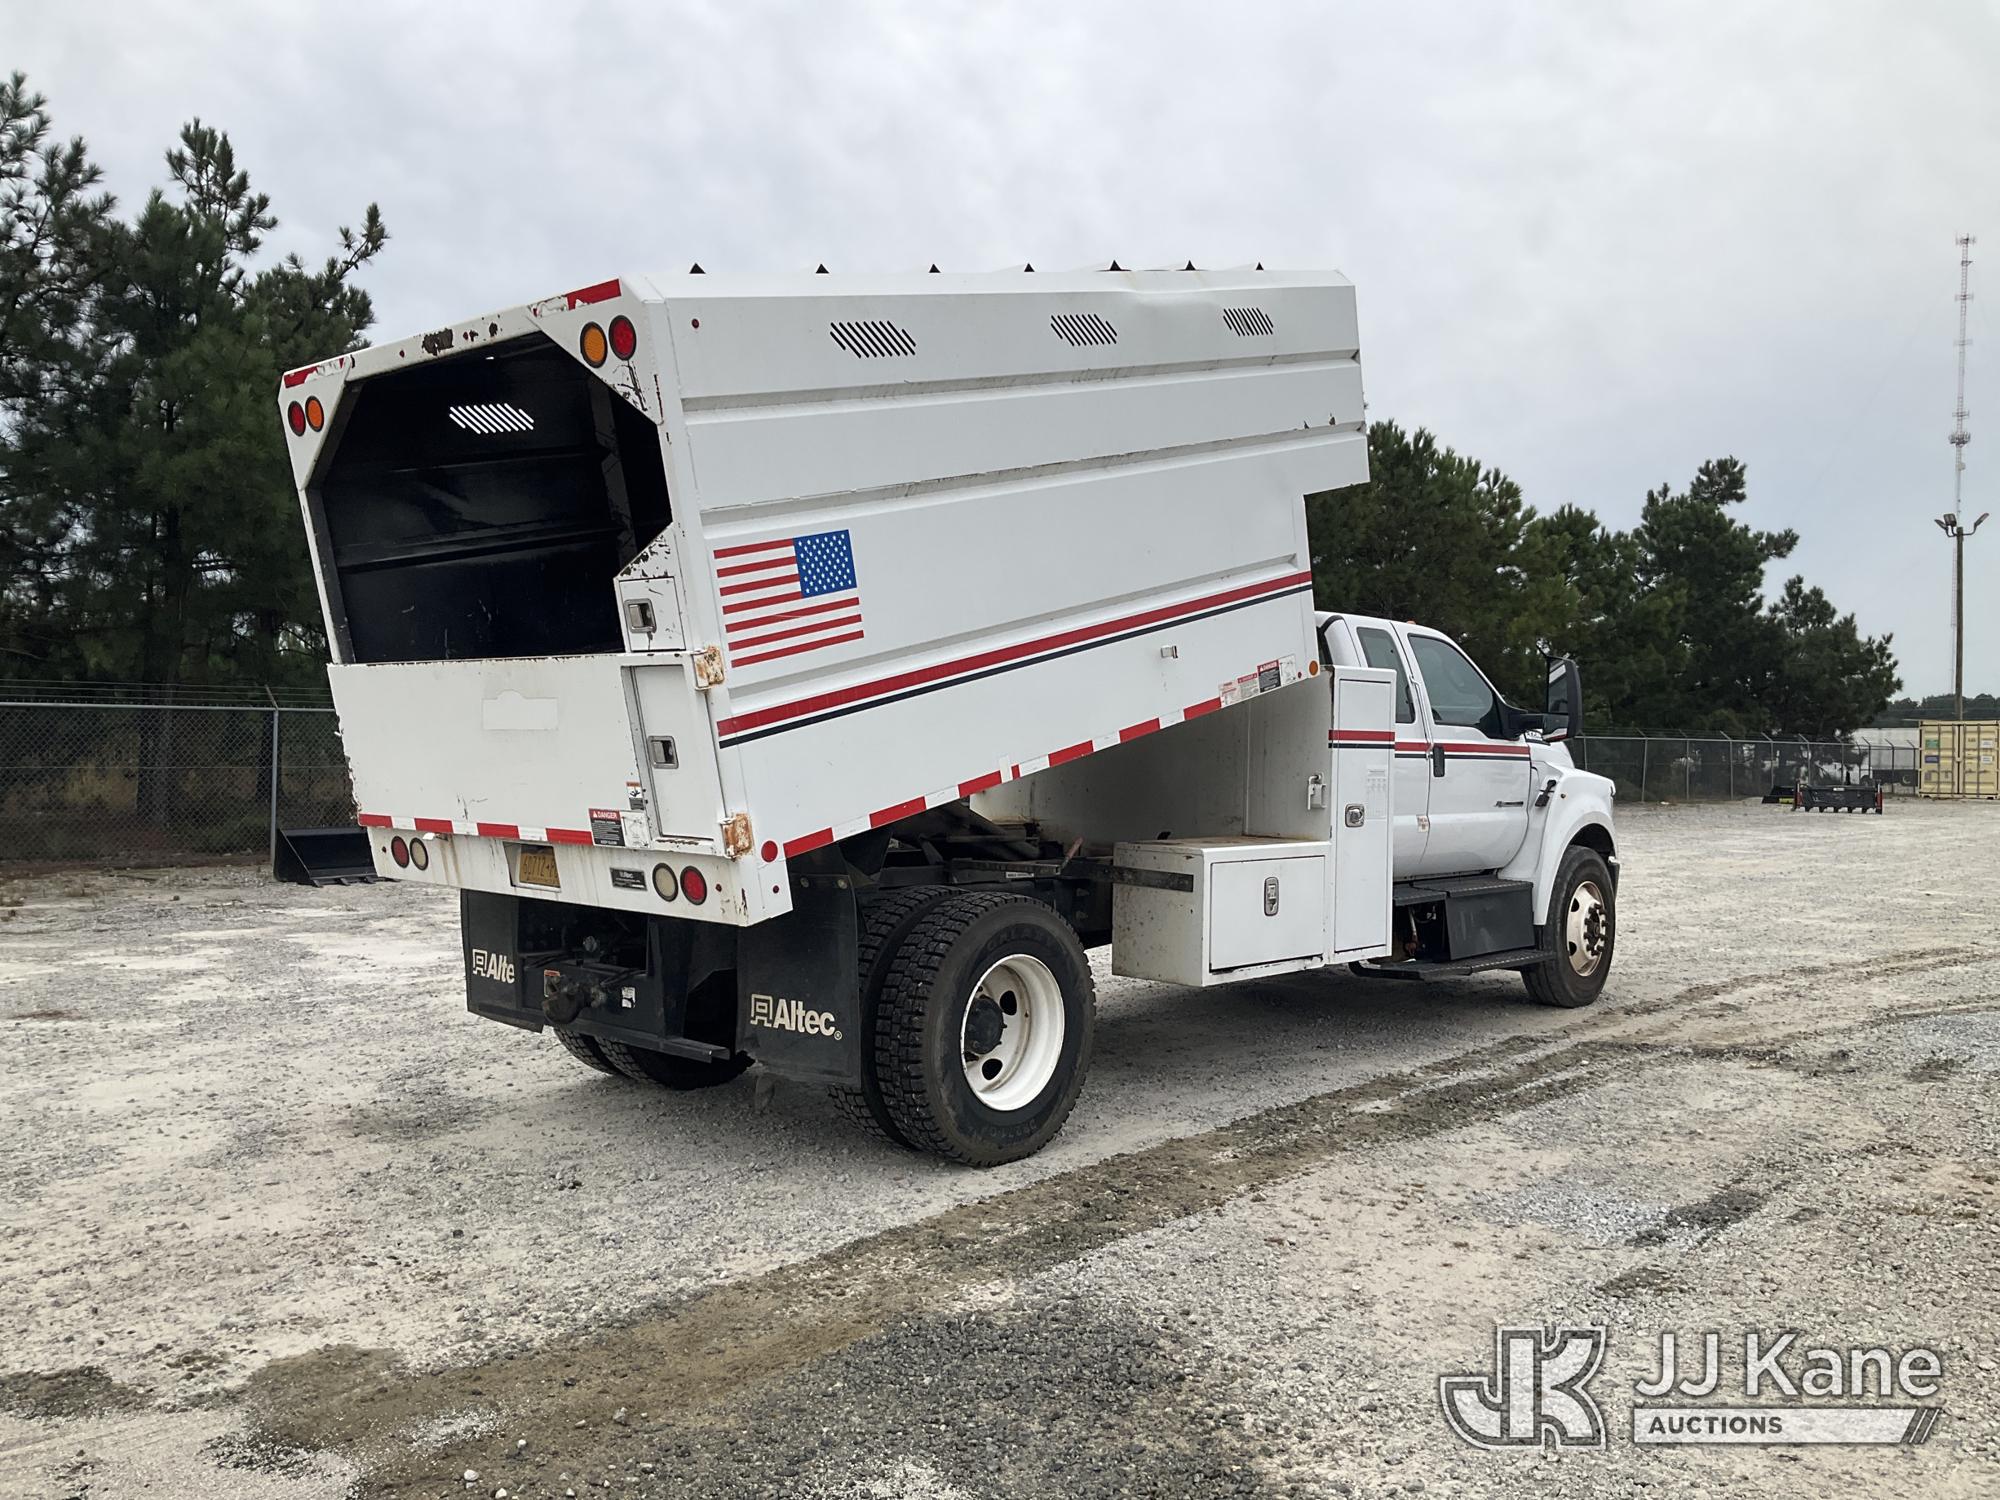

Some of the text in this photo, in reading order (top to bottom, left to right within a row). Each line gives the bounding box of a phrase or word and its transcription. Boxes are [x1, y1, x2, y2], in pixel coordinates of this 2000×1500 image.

[597, 811, 617, 819] DANGER
[486, 953, 515, 984] Alte
[773, 998, 836, 1037] Altec
